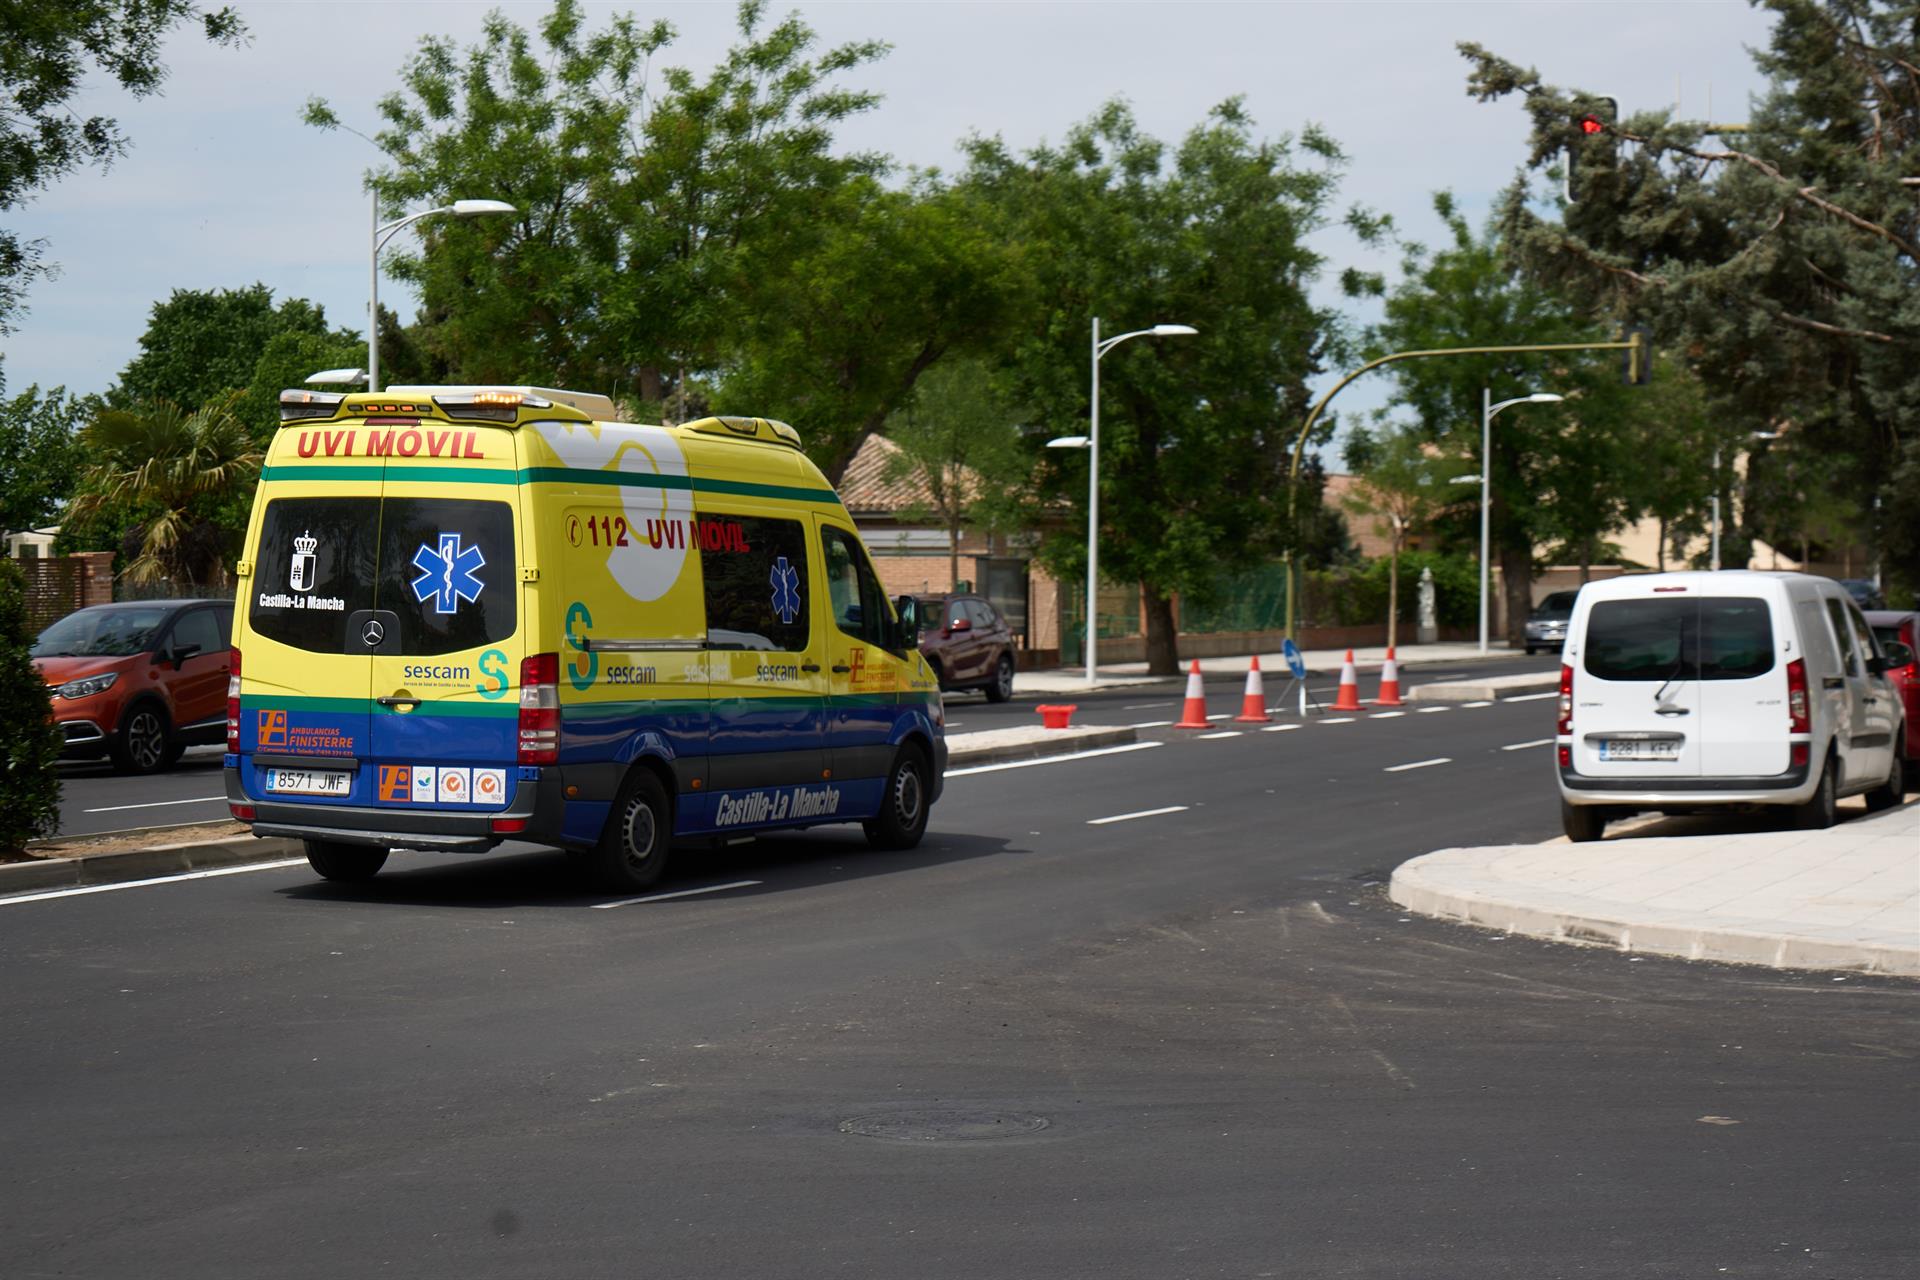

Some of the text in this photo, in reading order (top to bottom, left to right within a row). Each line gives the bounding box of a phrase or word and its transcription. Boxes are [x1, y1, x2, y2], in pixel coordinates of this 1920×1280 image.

[297, 425, 484, 460] UVI MÓVIL
[587, 515, 628, 547] 112
[647, 519, 685, 550] UVI
[259, 593, 345, 611] Castilla-La Mancha
[404, 665, 470, 680] sescam
[607, 665, 657, 685] sescam
[684, 663, 728, 683] sescam
[756, 664, 799, 682] sescam
[290, 727, 340, 736] AMBULANCIAS
[289, 735, 354, 748] FINISTERRE
[1610, 742, 1640, 756] 8281
[278, 772, 346, 790] 8571 JWF
[715, 784, 840, 827] Castilla-La Mancha
